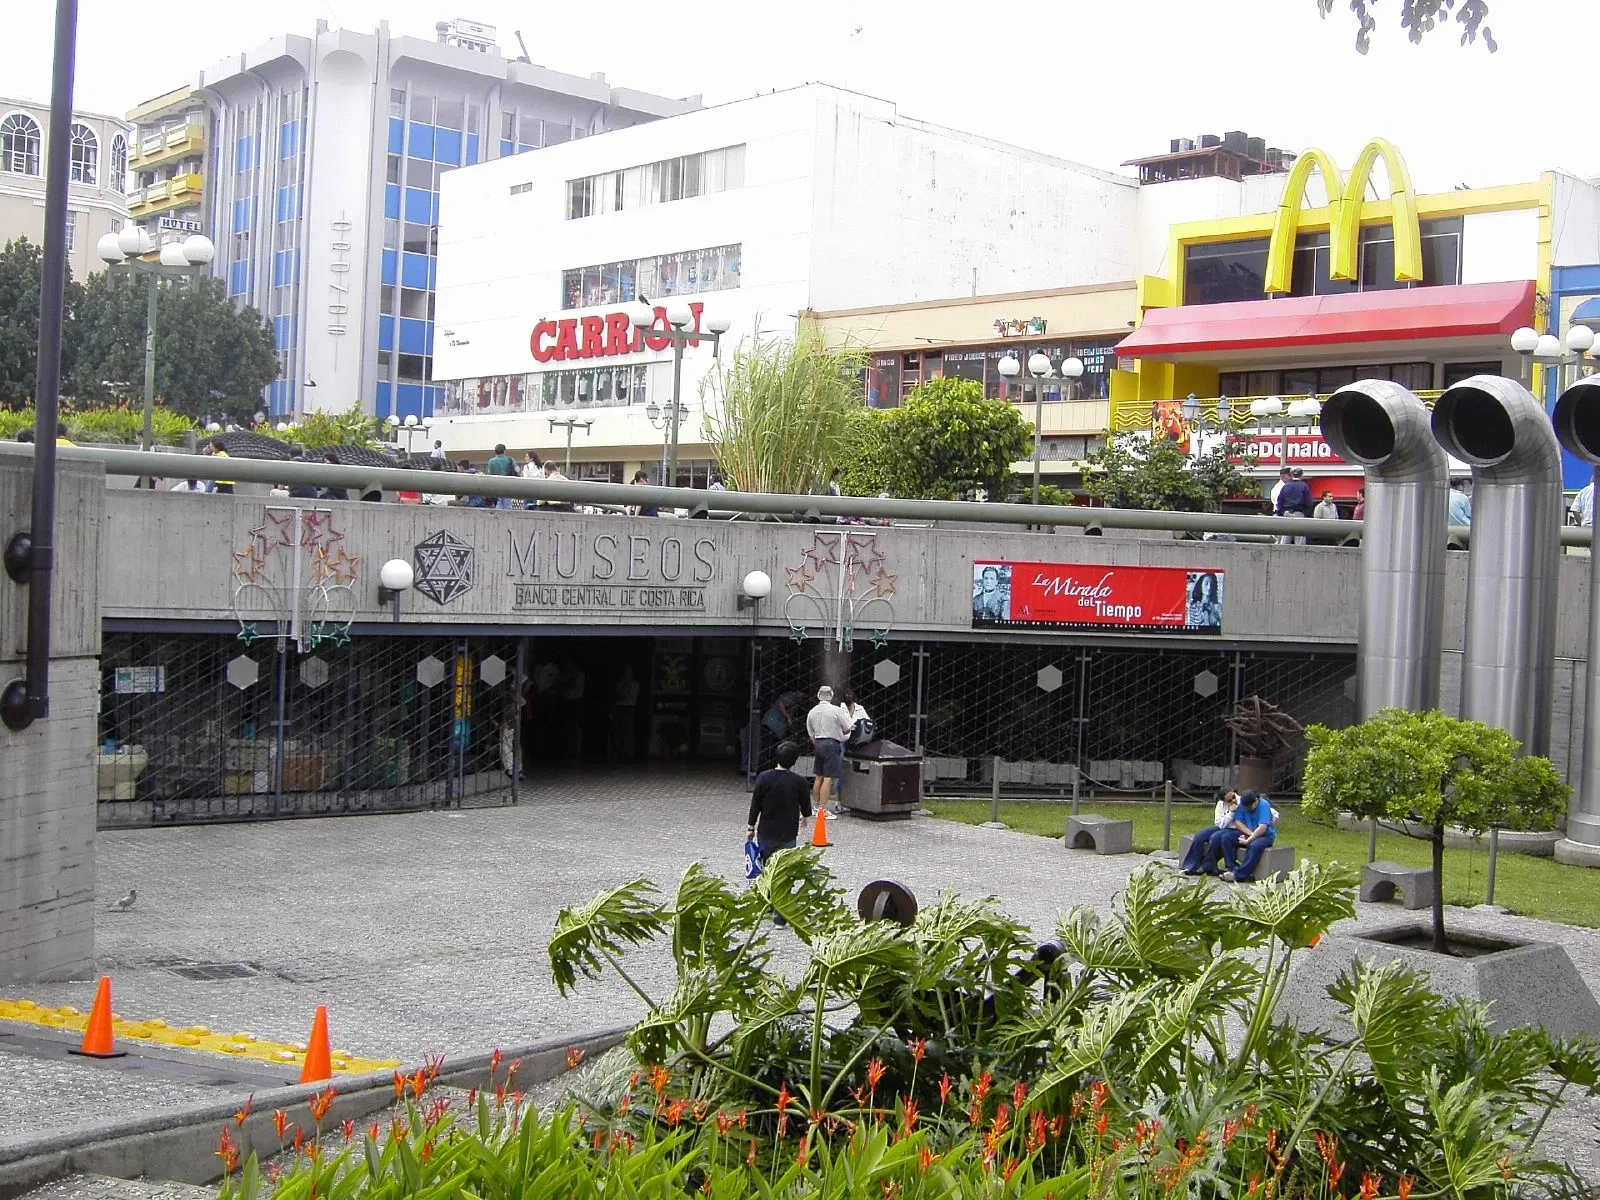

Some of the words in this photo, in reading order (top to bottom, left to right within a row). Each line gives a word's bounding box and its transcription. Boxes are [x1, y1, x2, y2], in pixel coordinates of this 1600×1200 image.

[162, 218, 201, 231] HOTEL
[506, 528, 717, 583] MUSEOS
[515, 585, 557, 606] BANCO
[561, 587, 616, 607] CENTRAL
[620, 588, 635, 607] DE
[639, 588, 676, 608] COSTA
[679, 589, 705, 608] RICA
[1032, 573, 1050, 587] La
[1044, 571, 1114, 598] Mirada
[1077, 597, 1096, 607] del
[1095, 600, 1142, 621] Tiempo
